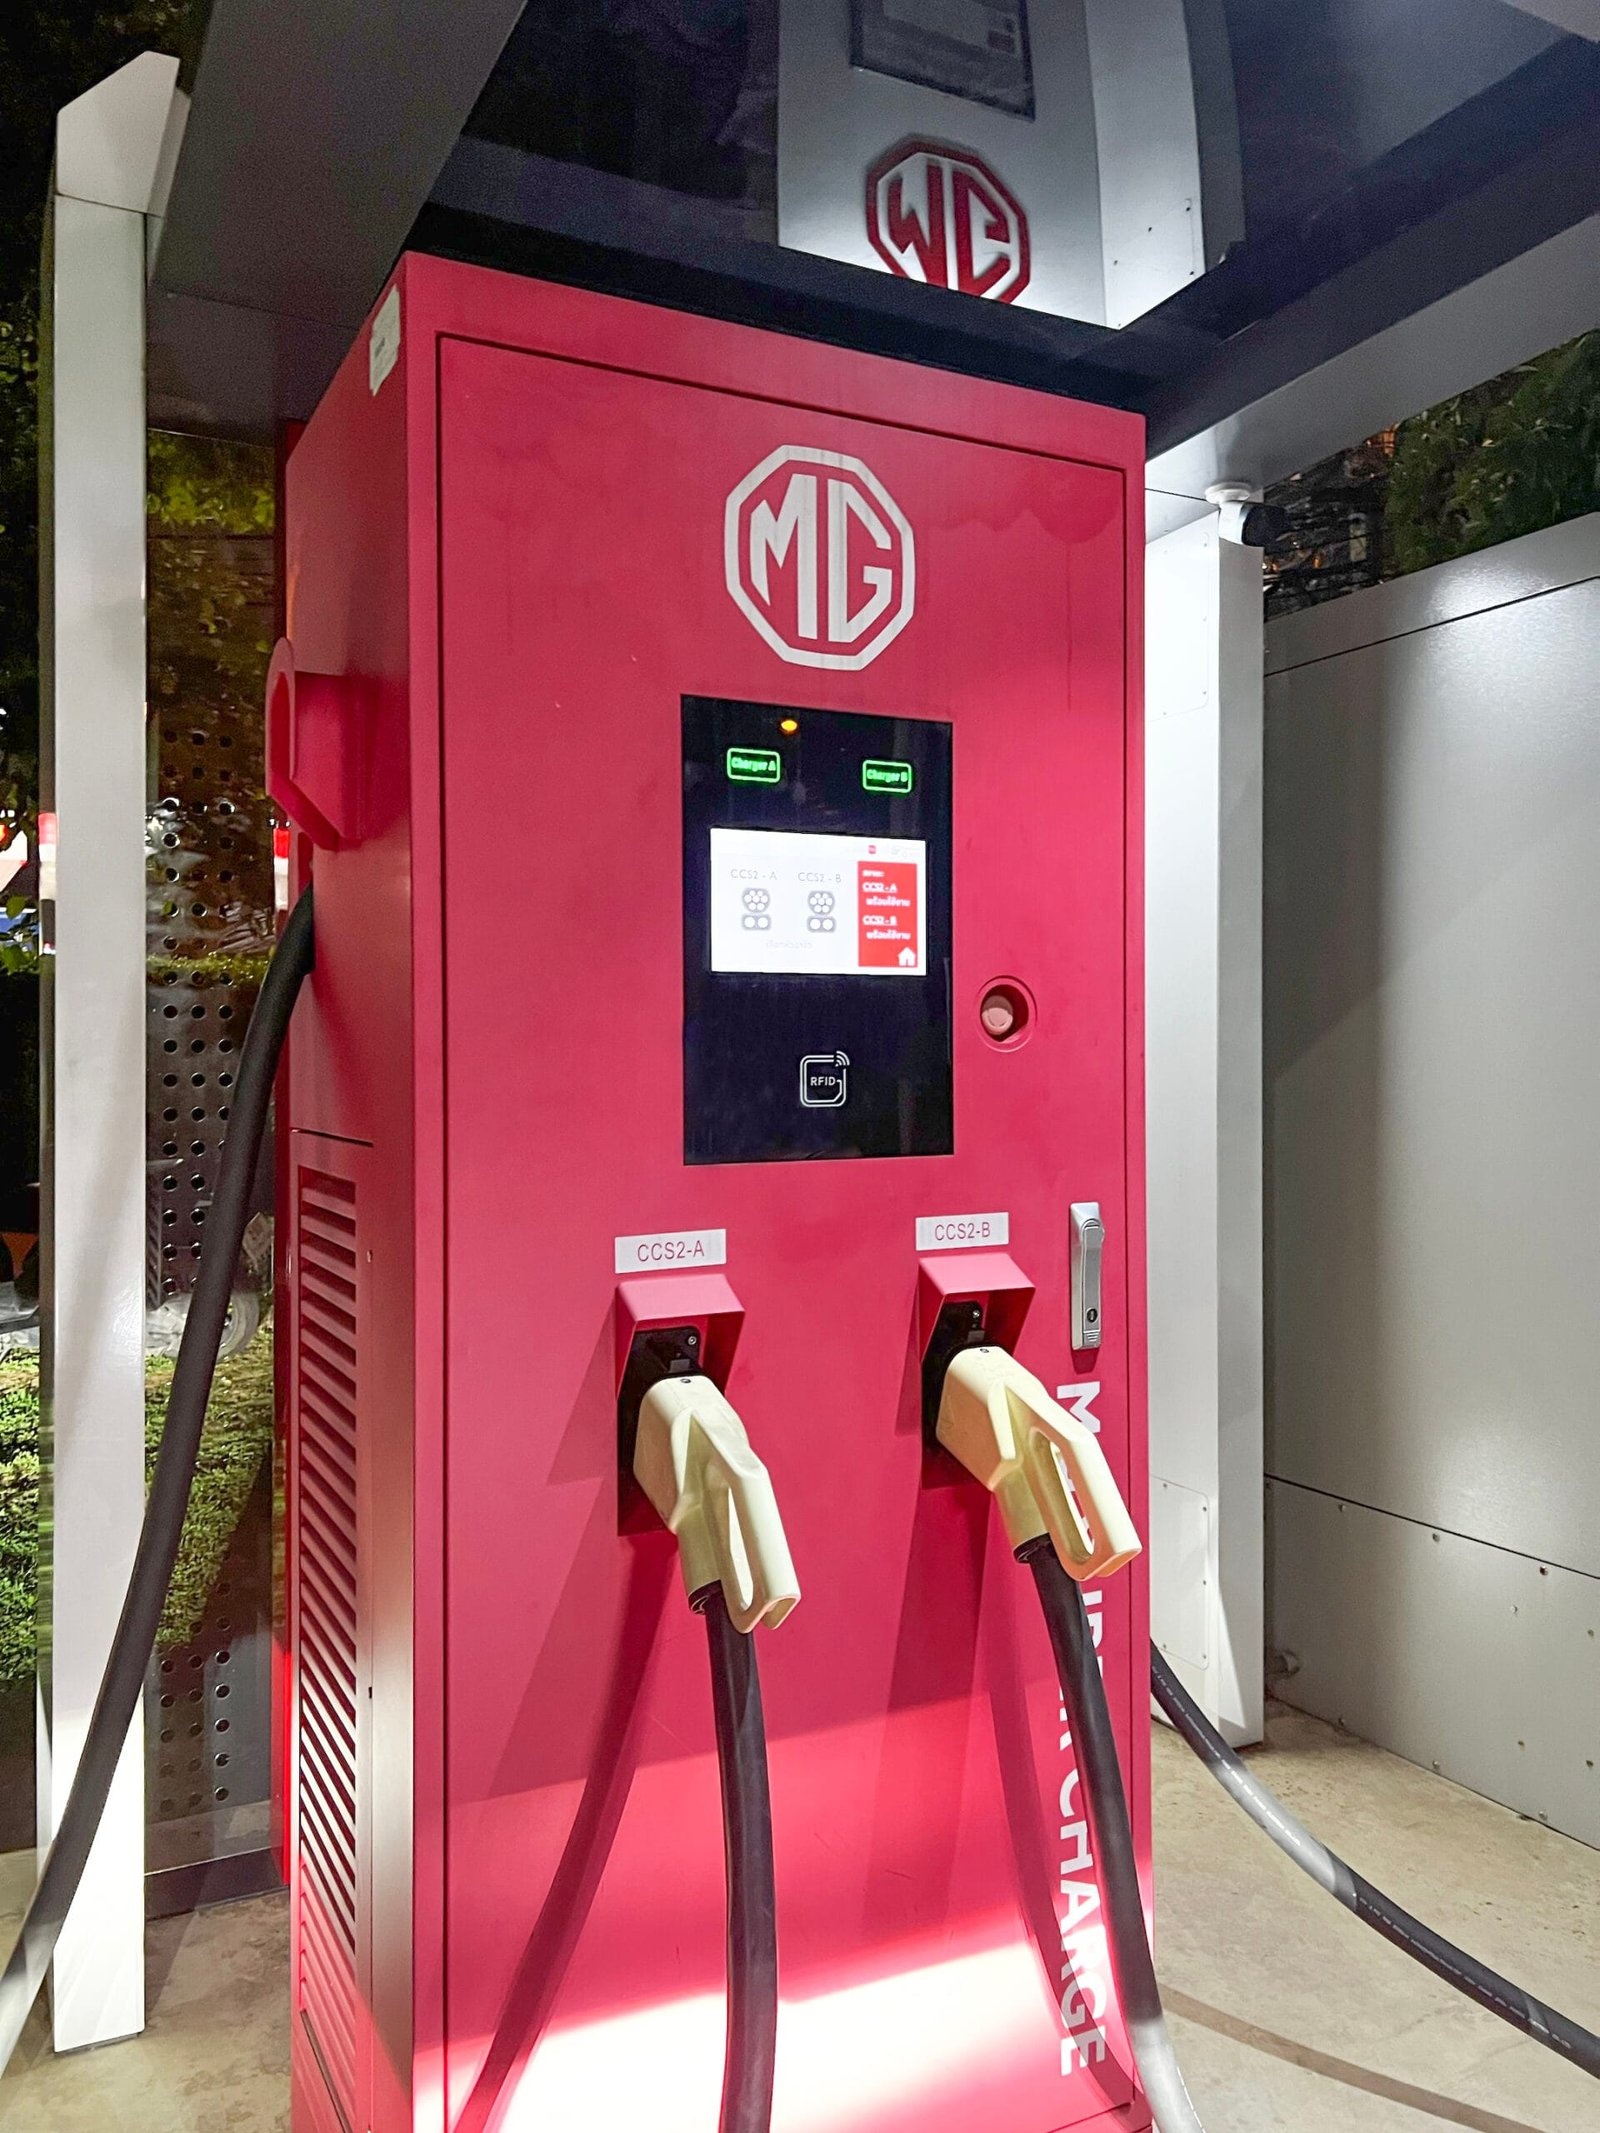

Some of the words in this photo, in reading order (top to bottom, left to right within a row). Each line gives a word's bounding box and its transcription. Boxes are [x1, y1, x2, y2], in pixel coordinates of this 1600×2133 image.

[750, 474, 892, 642] MG
[731, 757, 768, 771] Charger
[768, 761, 777, 771] A
[866, 769, 900, 783] Charger
[730, 868, 759, 880] CCS2
[810, 1076, 836, 1086] RFID
[933, 1221, 991, 1242] CCS2-B
[636, 1239, 705, 1263] CCS2-A
